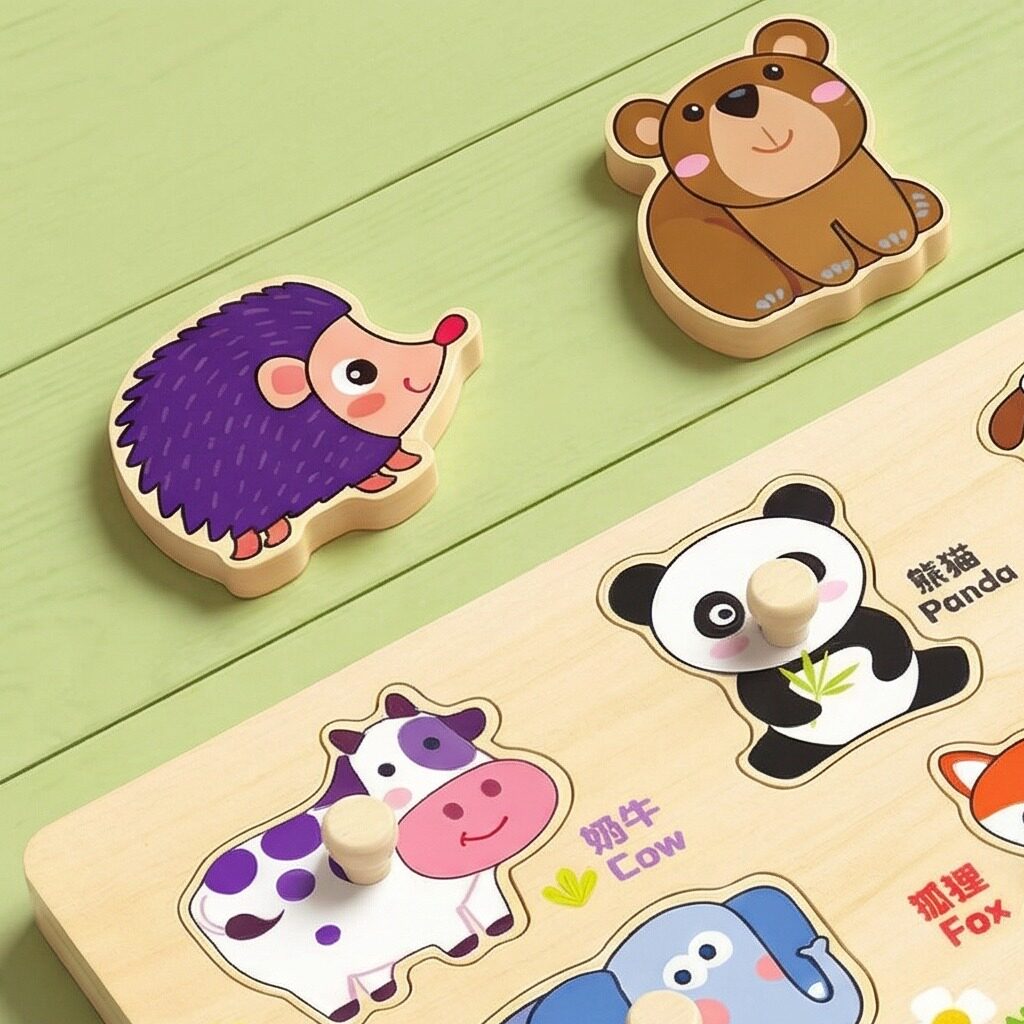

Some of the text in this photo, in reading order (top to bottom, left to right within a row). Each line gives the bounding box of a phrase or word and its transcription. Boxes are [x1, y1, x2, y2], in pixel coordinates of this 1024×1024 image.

[917, 564, 1019, 624] Panda
[606, 830, 686, 881] Cow
[907, 862, 991, 922] 狐狸
[938, 898, 1012, 948] Fox
